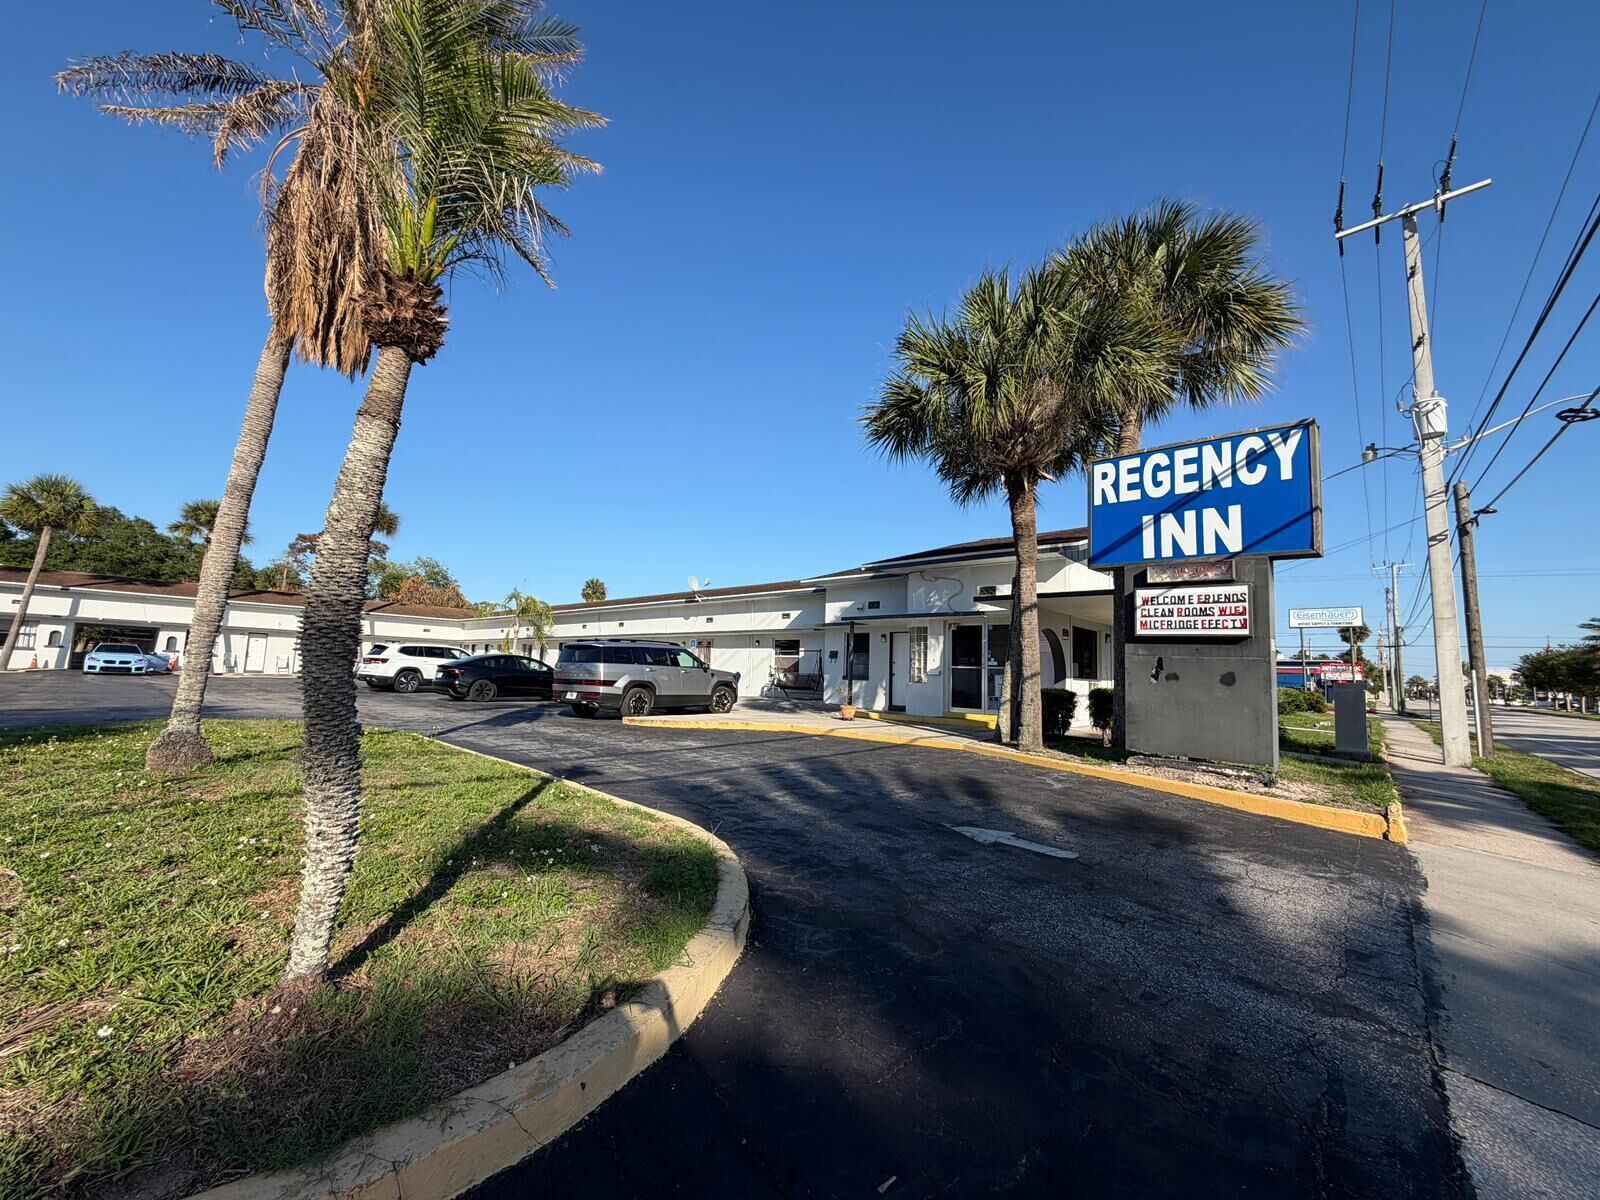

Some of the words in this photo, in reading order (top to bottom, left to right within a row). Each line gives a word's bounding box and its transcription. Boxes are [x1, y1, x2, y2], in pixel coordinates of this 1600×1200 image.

[1094, 429, 1303, 506] REGENCY
[1142, 504, 1243, 559] INN
[1140, 607, 1174, 618] CLEAN
[1177, 606, 1215, 617] ROOMS
[1141, 594, 1194, 605] WELCOME
[1197, 592, 1247, 604] FRIENDS
